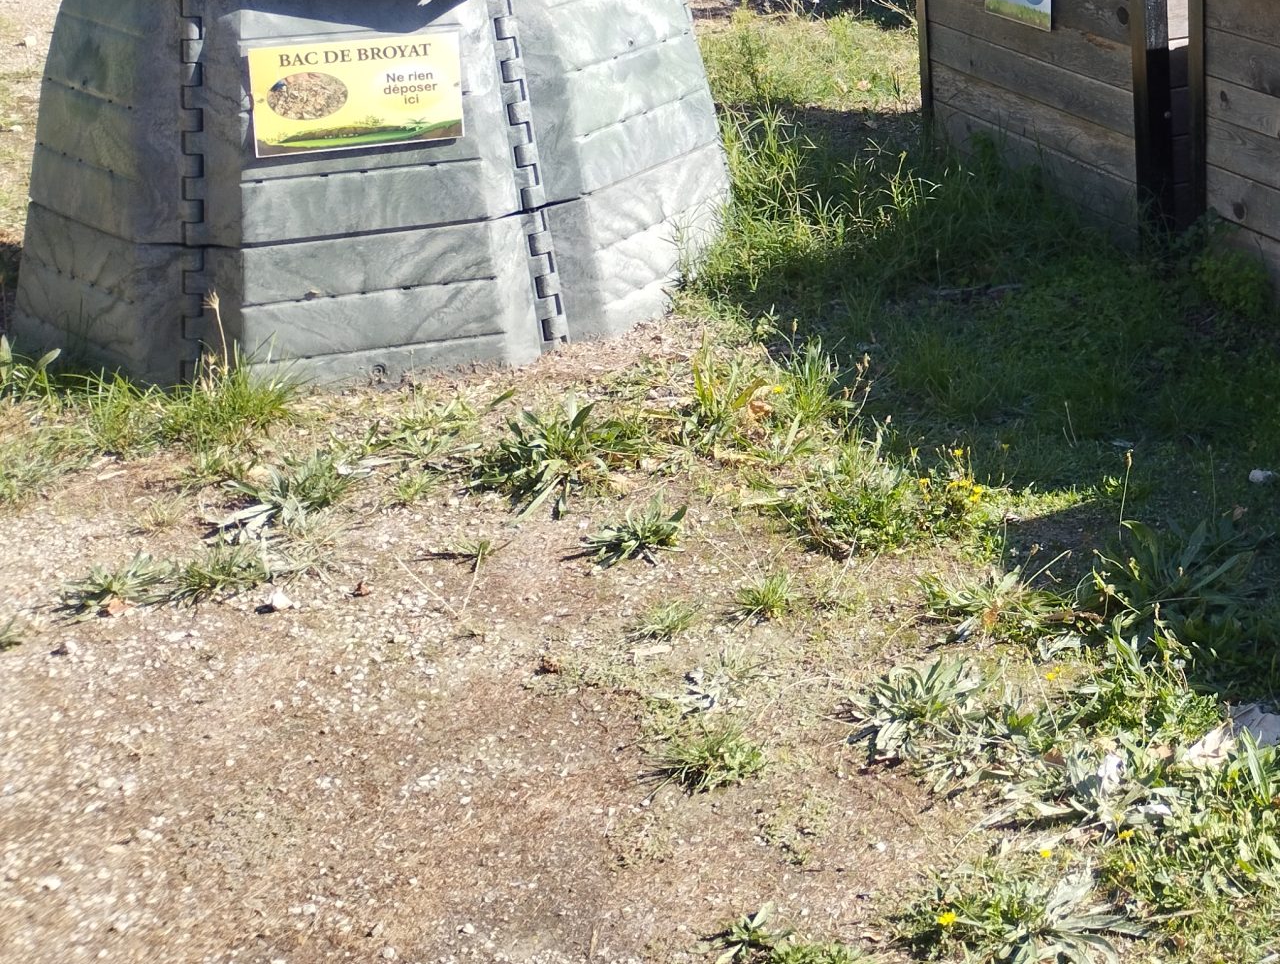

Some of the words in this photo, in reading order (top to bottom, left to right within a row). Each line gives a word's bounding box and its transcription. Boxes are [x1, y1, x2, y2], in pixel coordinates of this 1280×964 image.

[278, 52, 318, 68] BAC
[323, 49, 352, 64] DE
[357, 43, 432, 61] BROYAT
[386, 73, 405, 83] Ne
[408, 71, 434, 81] rien
[383, 82, 438, 96] déposer
[404, 95, 420, 105] ici
